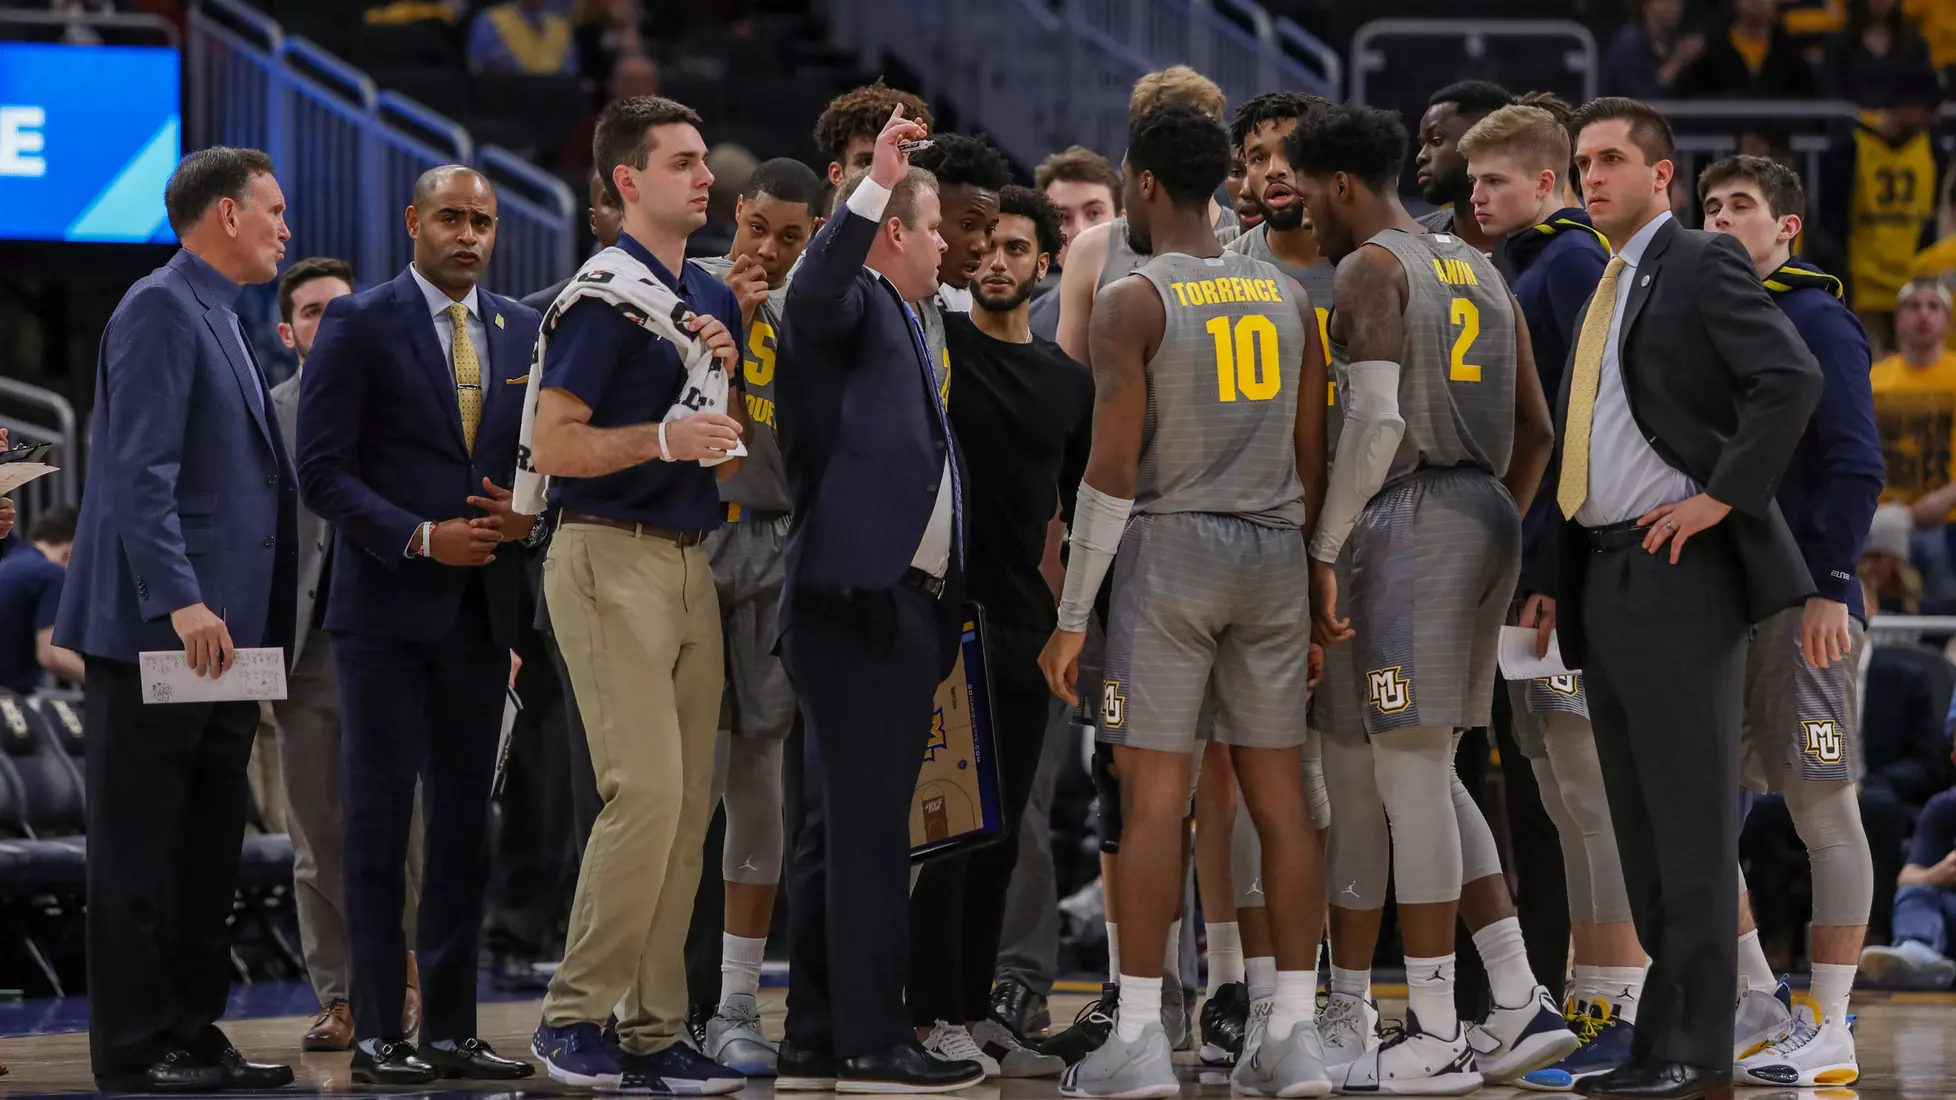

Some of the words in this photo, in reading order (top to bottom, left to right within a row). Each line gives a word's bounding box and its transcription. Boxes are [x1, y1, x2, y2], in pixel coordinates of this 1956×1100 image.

[1170, 276, 1284, 307] TORRENCE
[743, 320, 777, 387] 5
[1205, 314, 1282, 402] 10
[1449, 297, 1482, 383] 2
[1364, 665, 1412, 714] MU
[1801, 719, 1843, 764] MU
